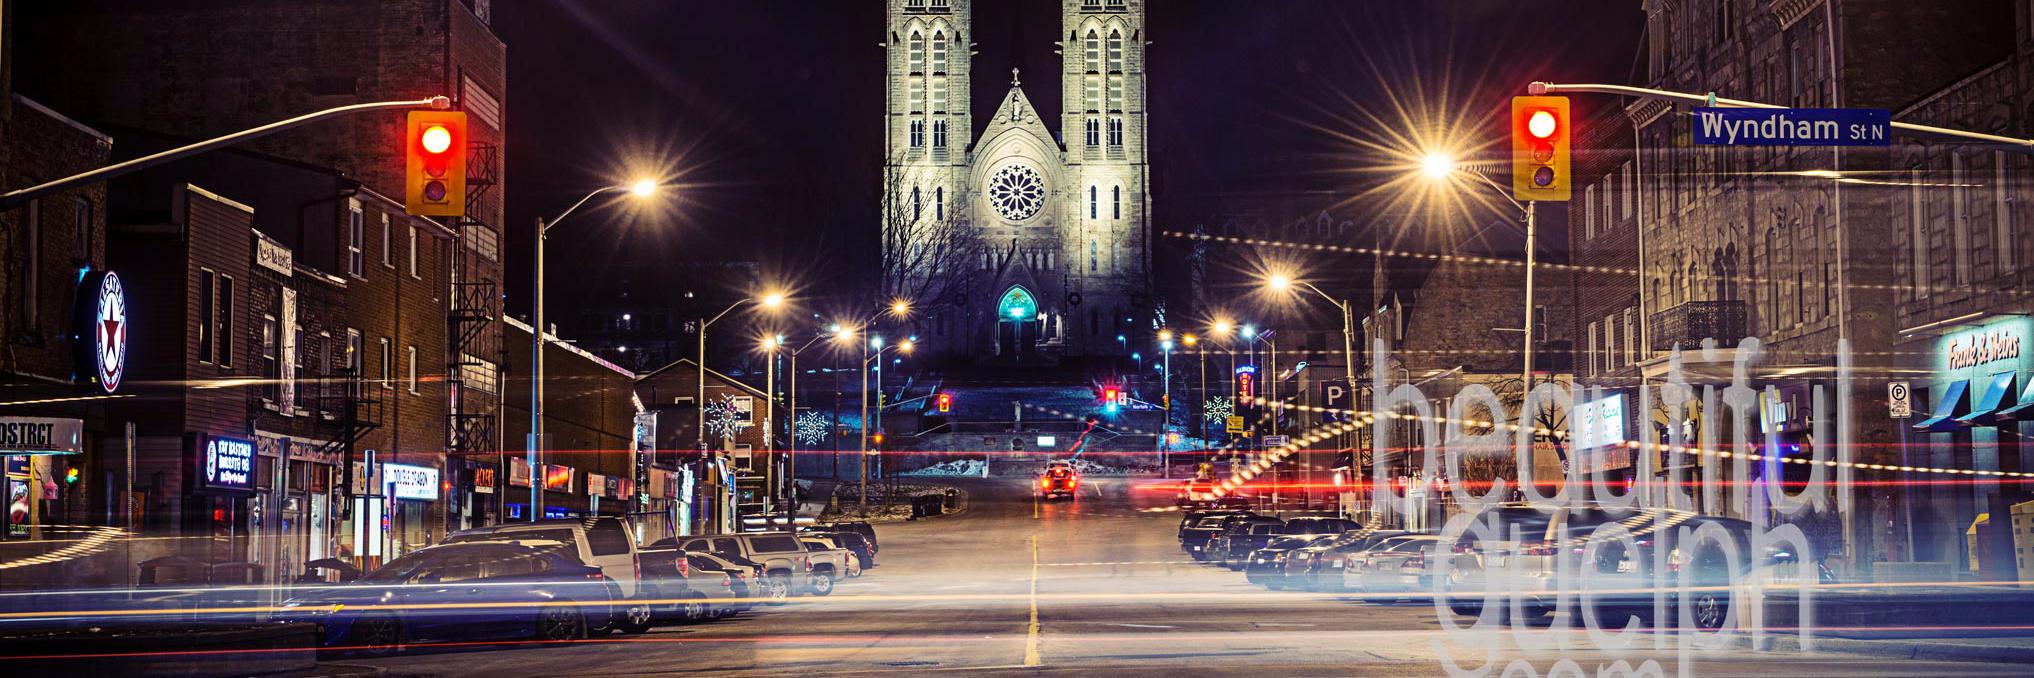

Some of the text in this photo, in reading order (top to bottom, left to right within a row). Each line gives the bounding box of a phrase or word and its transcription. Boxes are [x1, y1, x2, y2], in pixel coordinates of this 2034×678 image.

[1702, 113, 1883, 144] Wyndham St N
[1948, 335, 1978, 369] Frank
[1979, 335, 1988, 365] &
[1327, 386, 1342, 405] P
